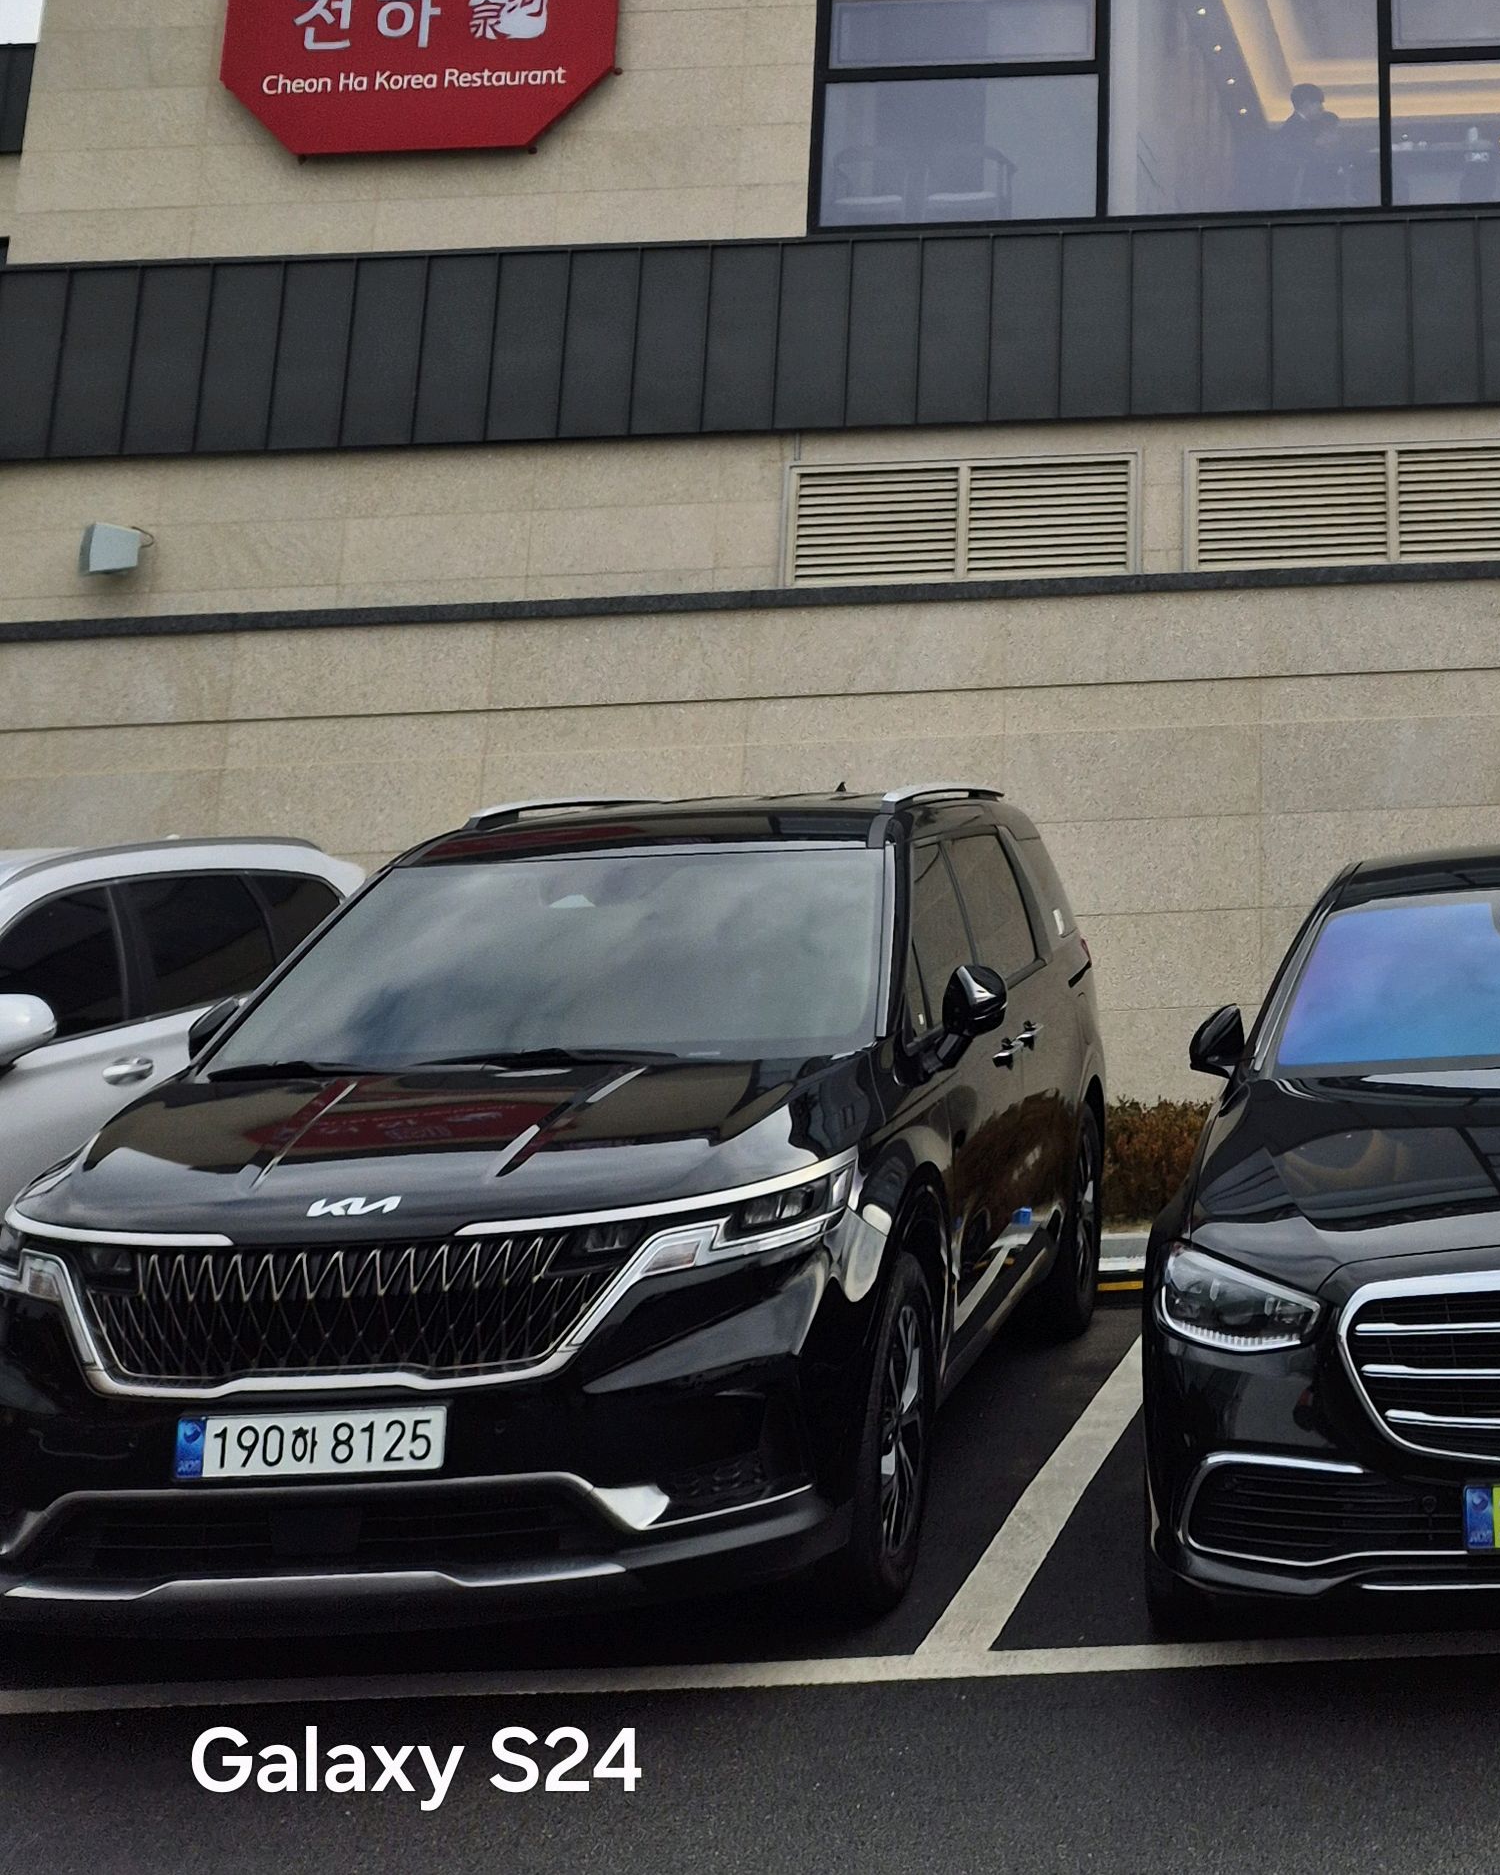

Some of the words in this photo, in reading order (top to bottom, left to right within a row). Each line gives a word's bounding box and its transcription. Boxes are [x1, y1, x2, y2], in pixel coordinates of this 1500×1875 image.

[261, 74, 331, 95] Cheon
[338, 72, 368, 92] Ha
[374, 70, 438, 91] Korea
[443, 66, 567, 88] Restaurant
[213, 1424, 318, 1469] 190하
[330, 1419, 432, 1464] 8125
